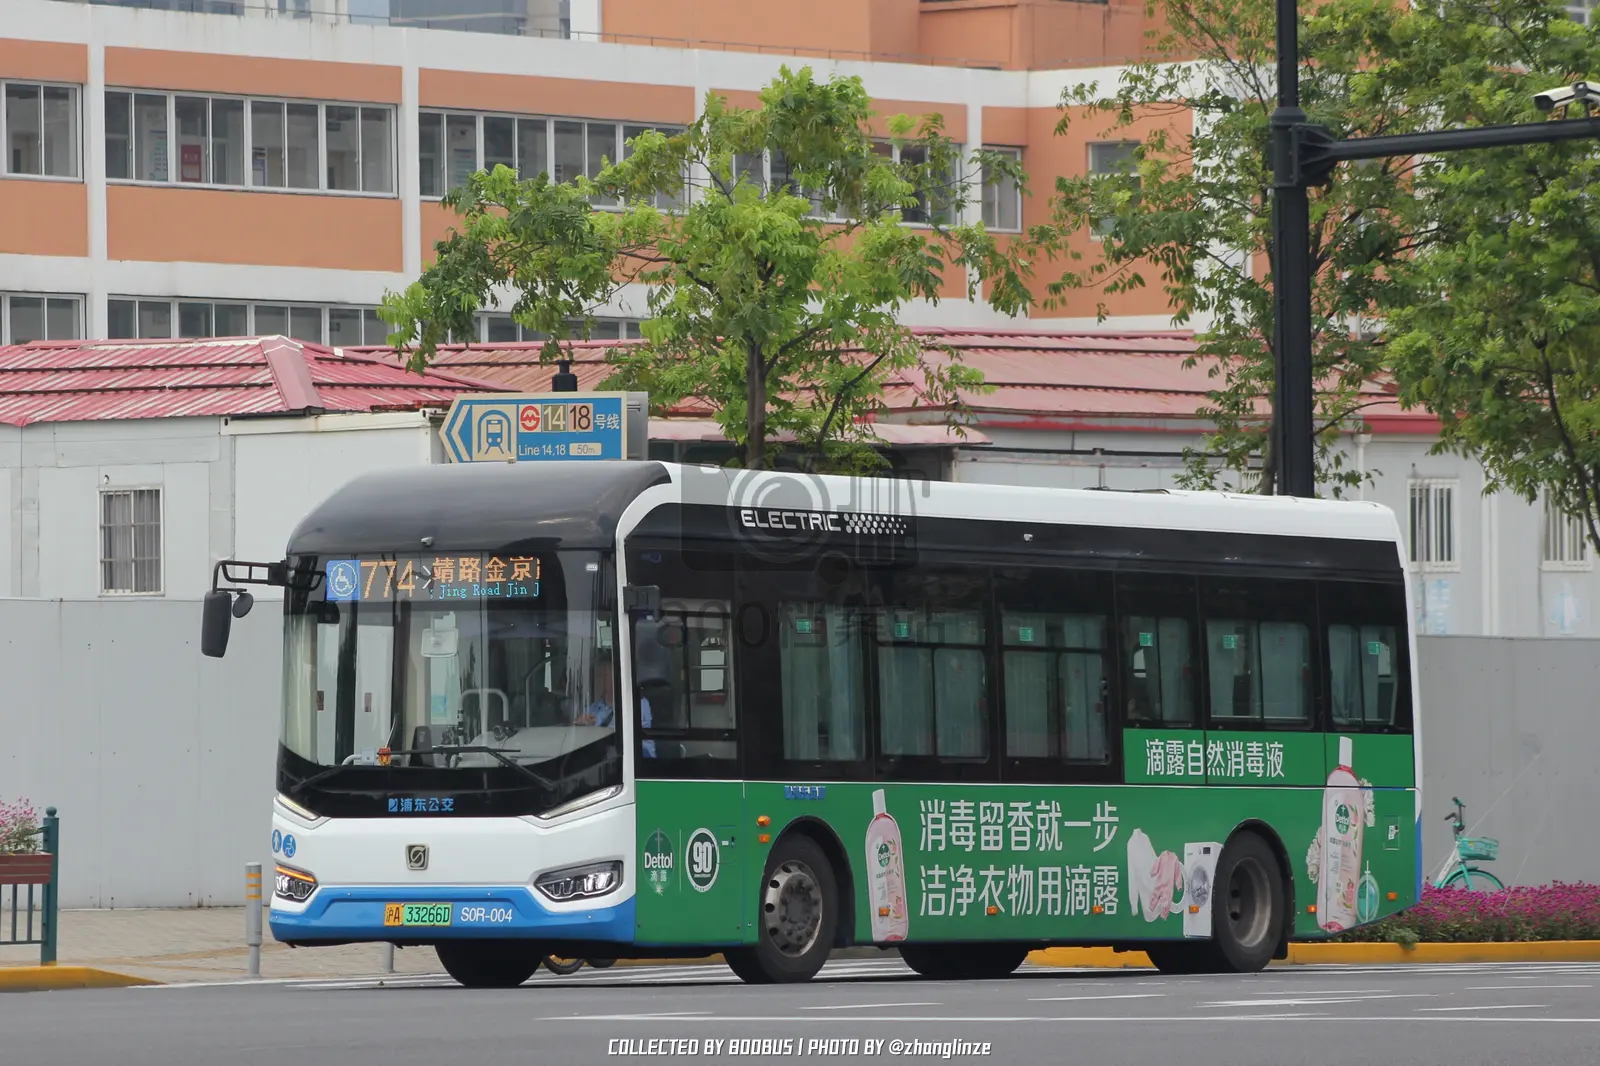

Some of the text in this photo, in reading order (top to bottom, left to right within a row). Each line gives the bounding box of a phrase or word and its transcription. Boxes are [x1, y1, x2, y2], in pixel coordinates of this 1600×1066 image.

[544, 405, 620, 430] 14 18 号线
[519, 444, 565, 456] Line 14,18
[740, 509, 841, 532] ELECTRIC
[360, 560, 416, 598] 774
[432, 556, 541, 584] 靖路金京
[439, 584, 468, 600] Jing
[473, 582, 501, 597] Road
[507, 582, 528, 598] Jin
[1145, 738, 1285, 778] 滴露自然消毒液
[400, 797, 454, 812] 浦东公交
[919, 798, 1120, 852] 消毒留香就一步
[644, 852, 673, 869] Dettol
[919, 864, 1120, 917] 洁净衣物用滴露
[406, 906, 450, 923] 33266D
